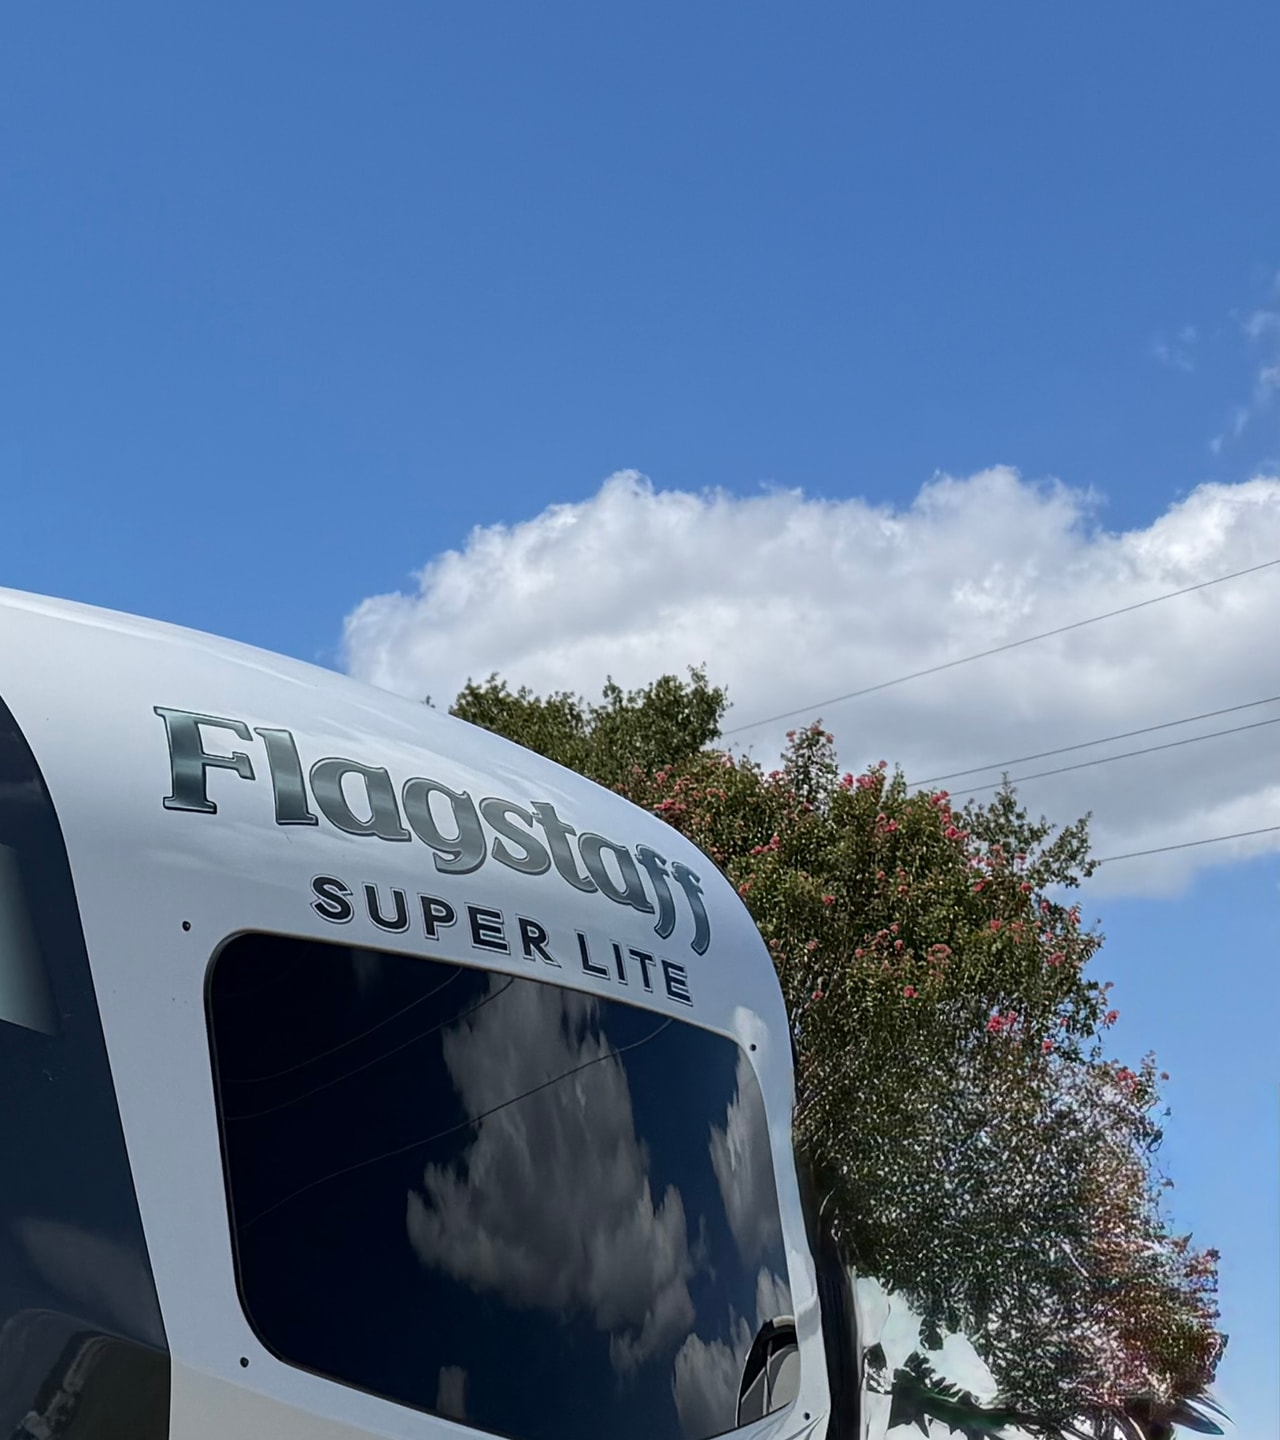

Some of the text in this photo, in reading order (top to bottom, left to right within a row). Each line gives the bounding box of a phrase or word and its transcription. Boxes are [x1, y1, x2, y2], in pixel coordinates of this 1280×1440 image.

[153, 705, 711, 957] Flagstaff
[309, 873, 694, 1008] SUPER LITE
